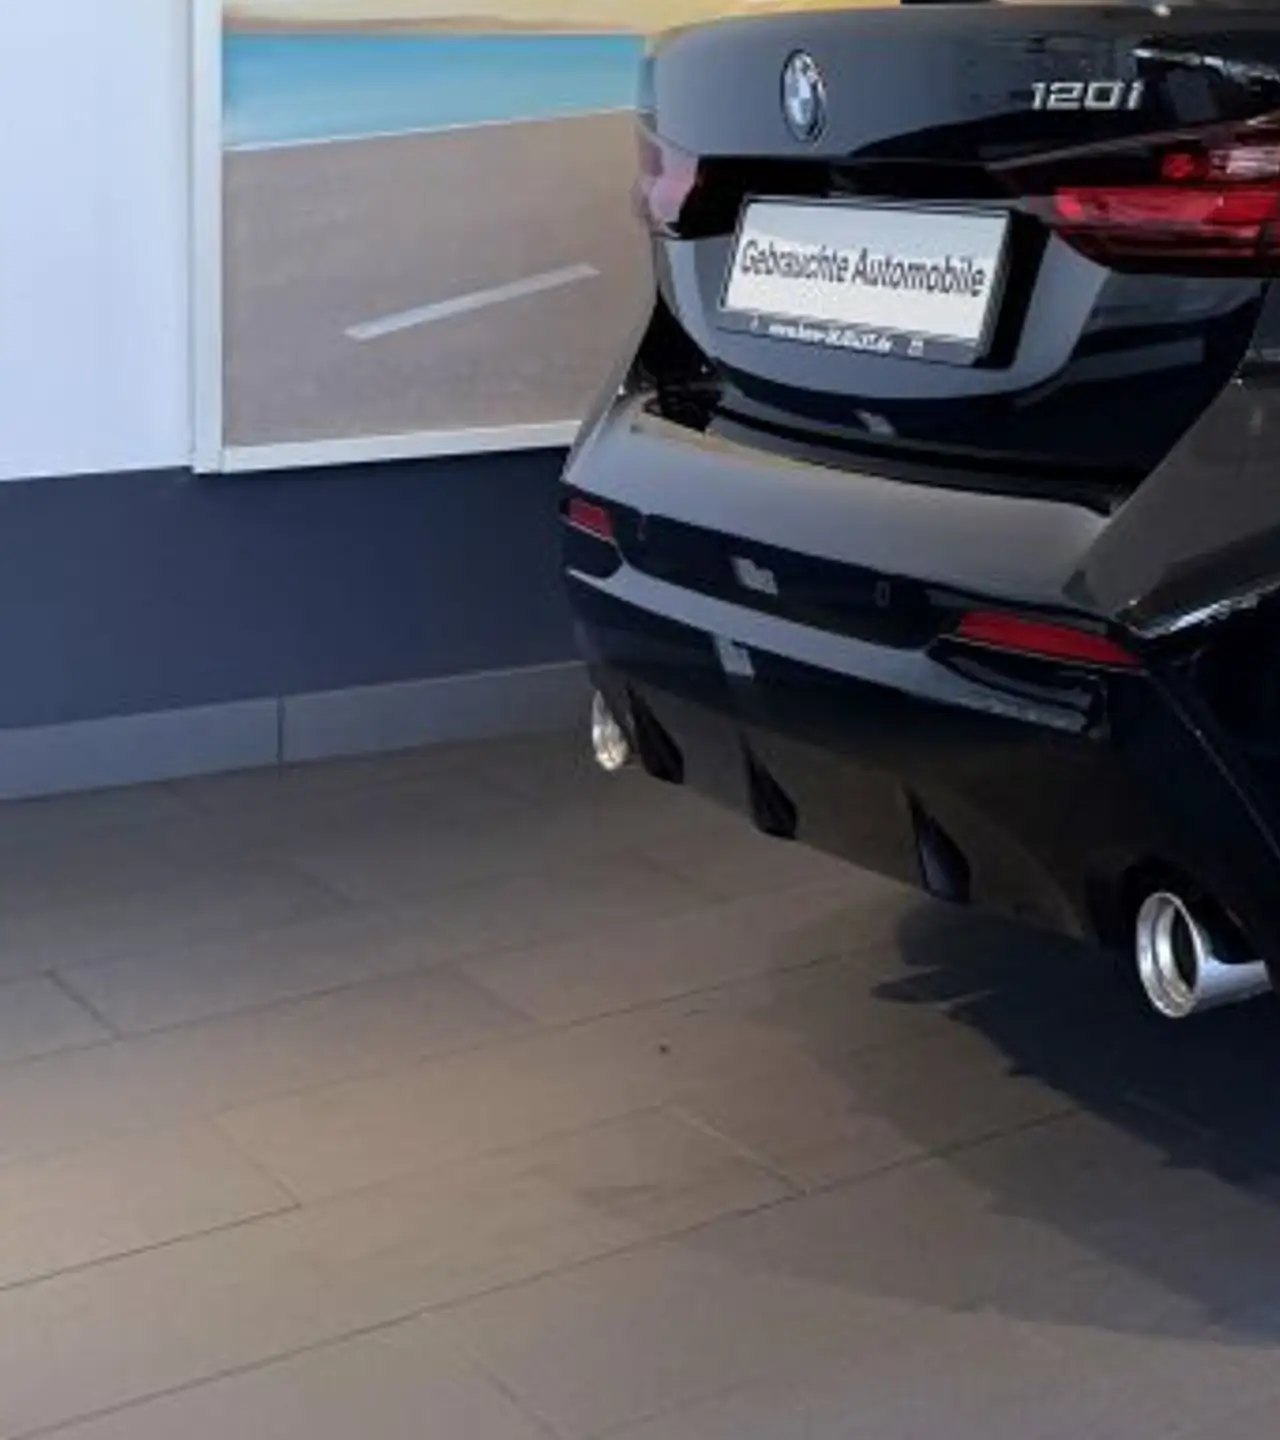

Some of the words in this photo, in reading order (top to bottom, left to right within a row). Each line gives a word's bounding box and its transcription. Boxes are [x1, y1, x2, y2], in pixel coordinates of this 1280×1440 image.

[1031, 81, 1143, 111] 120i
[741, 239, 849, 283] Gebrauchte
[852, 248, 987, 297] Automobile
